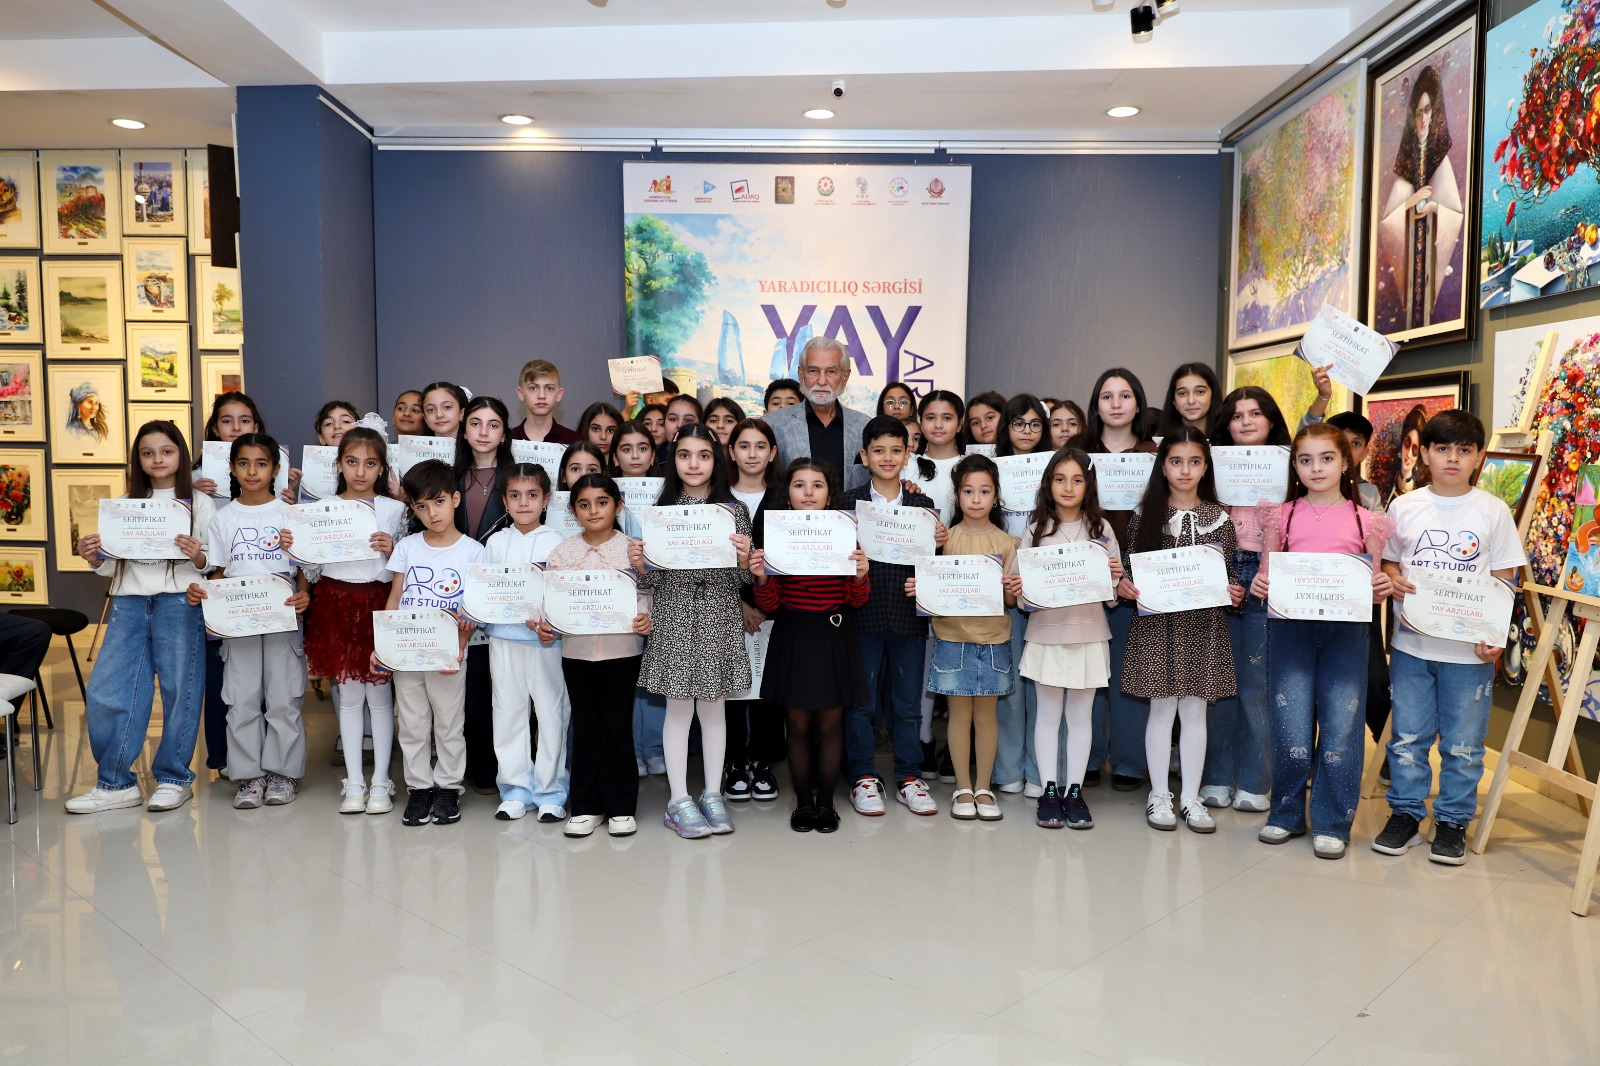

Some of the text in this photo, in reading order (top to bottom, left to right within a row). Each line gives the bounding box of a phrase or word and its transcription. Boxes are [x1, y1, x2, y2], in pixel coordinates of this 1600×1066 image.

[758, 280, 859, 296] YARADICILIQ
[760, 304, 923, 384] YAY
[1011, 468, 1043, 478] SERTİFİK
[1411, 560, 1431, 568] ART
[401, 597, 415, 605] ART
[1433, 588, 1486, 602] SERTİFİKAT
